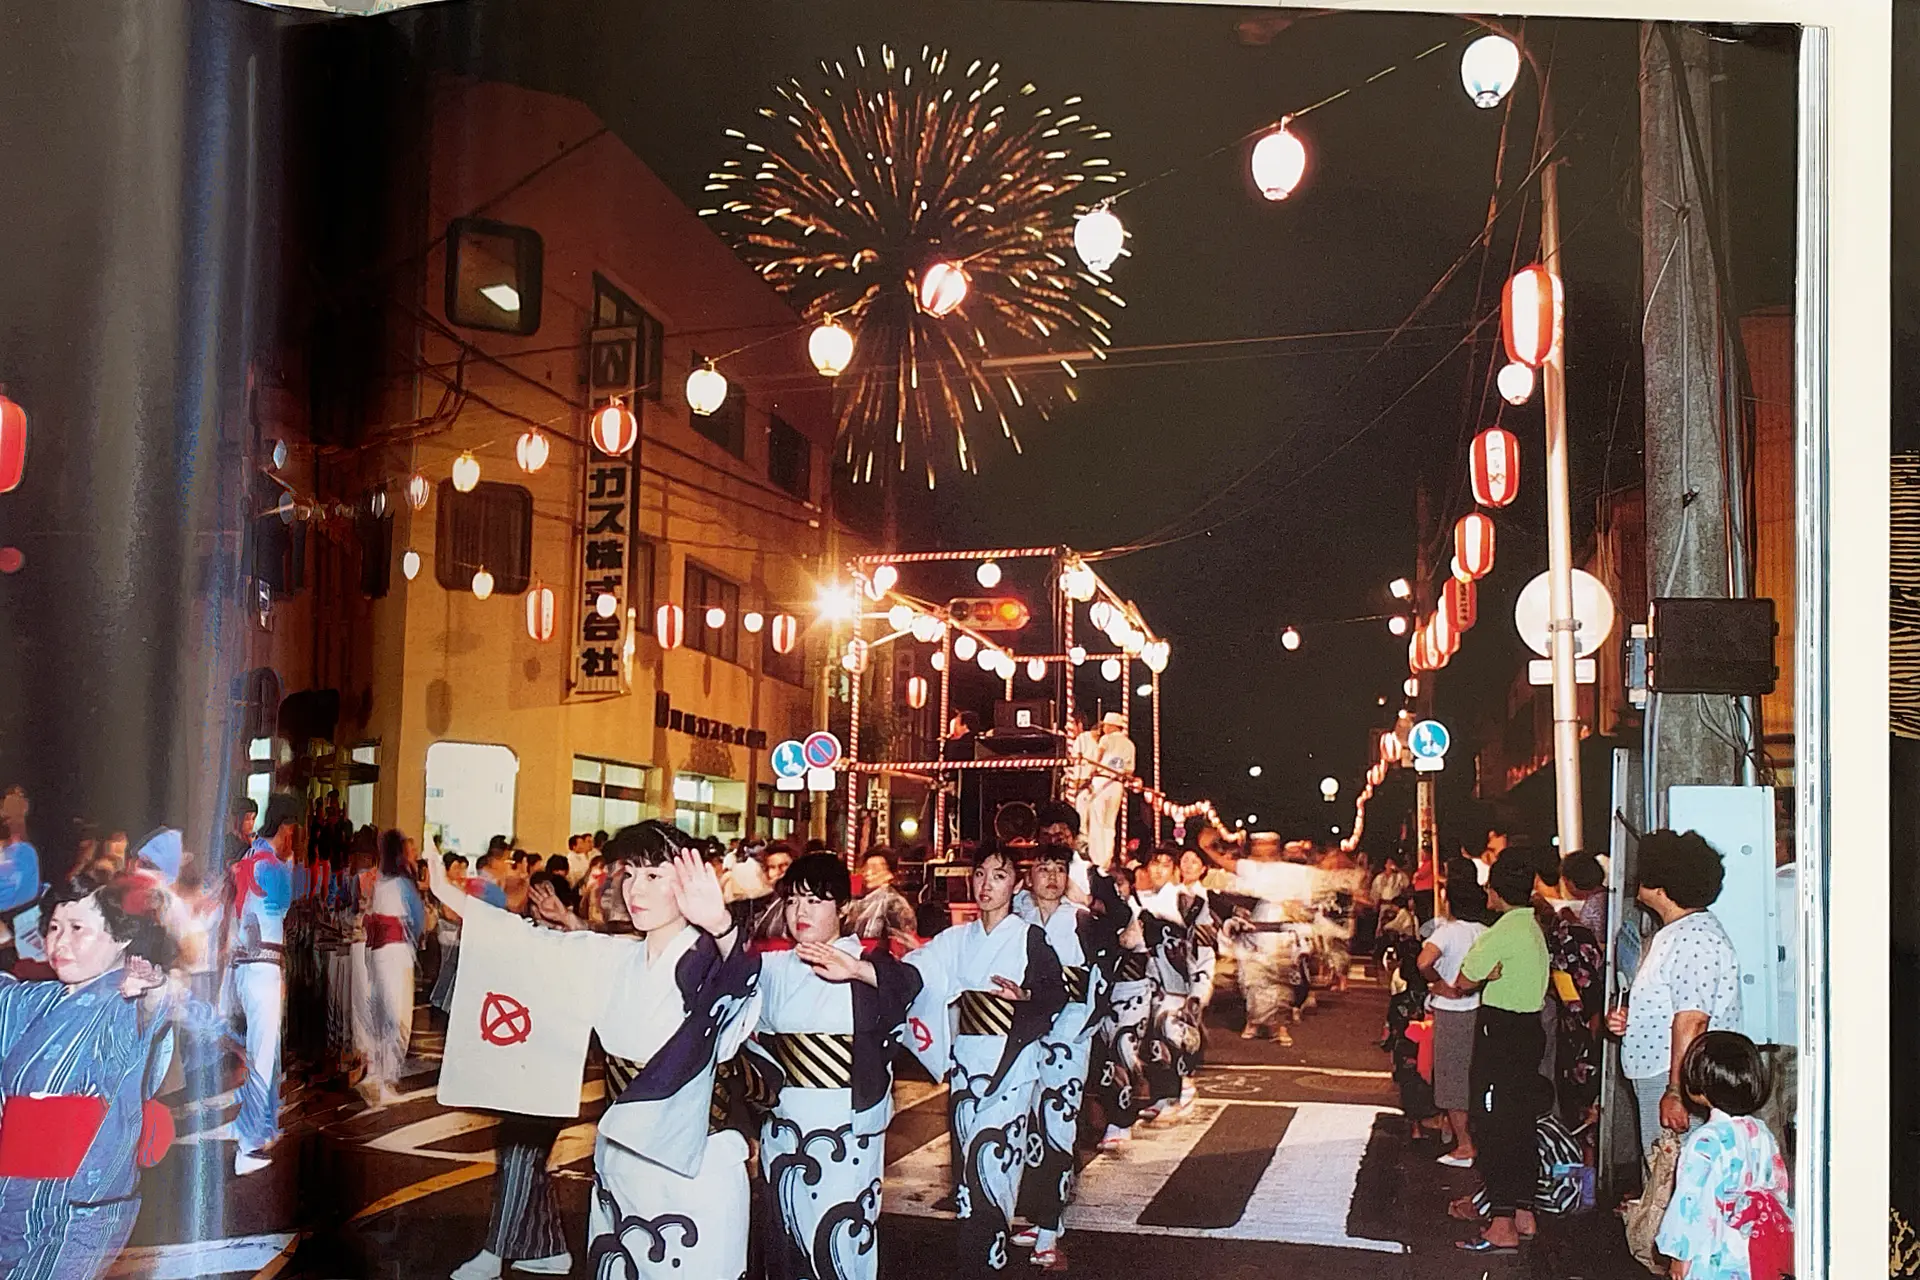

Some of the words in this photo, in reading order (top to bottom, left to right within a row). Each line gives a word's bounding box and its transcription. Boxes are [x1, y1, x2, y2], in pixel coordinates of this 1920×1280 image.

[581, 397, 627, 677] ガス株式会社
